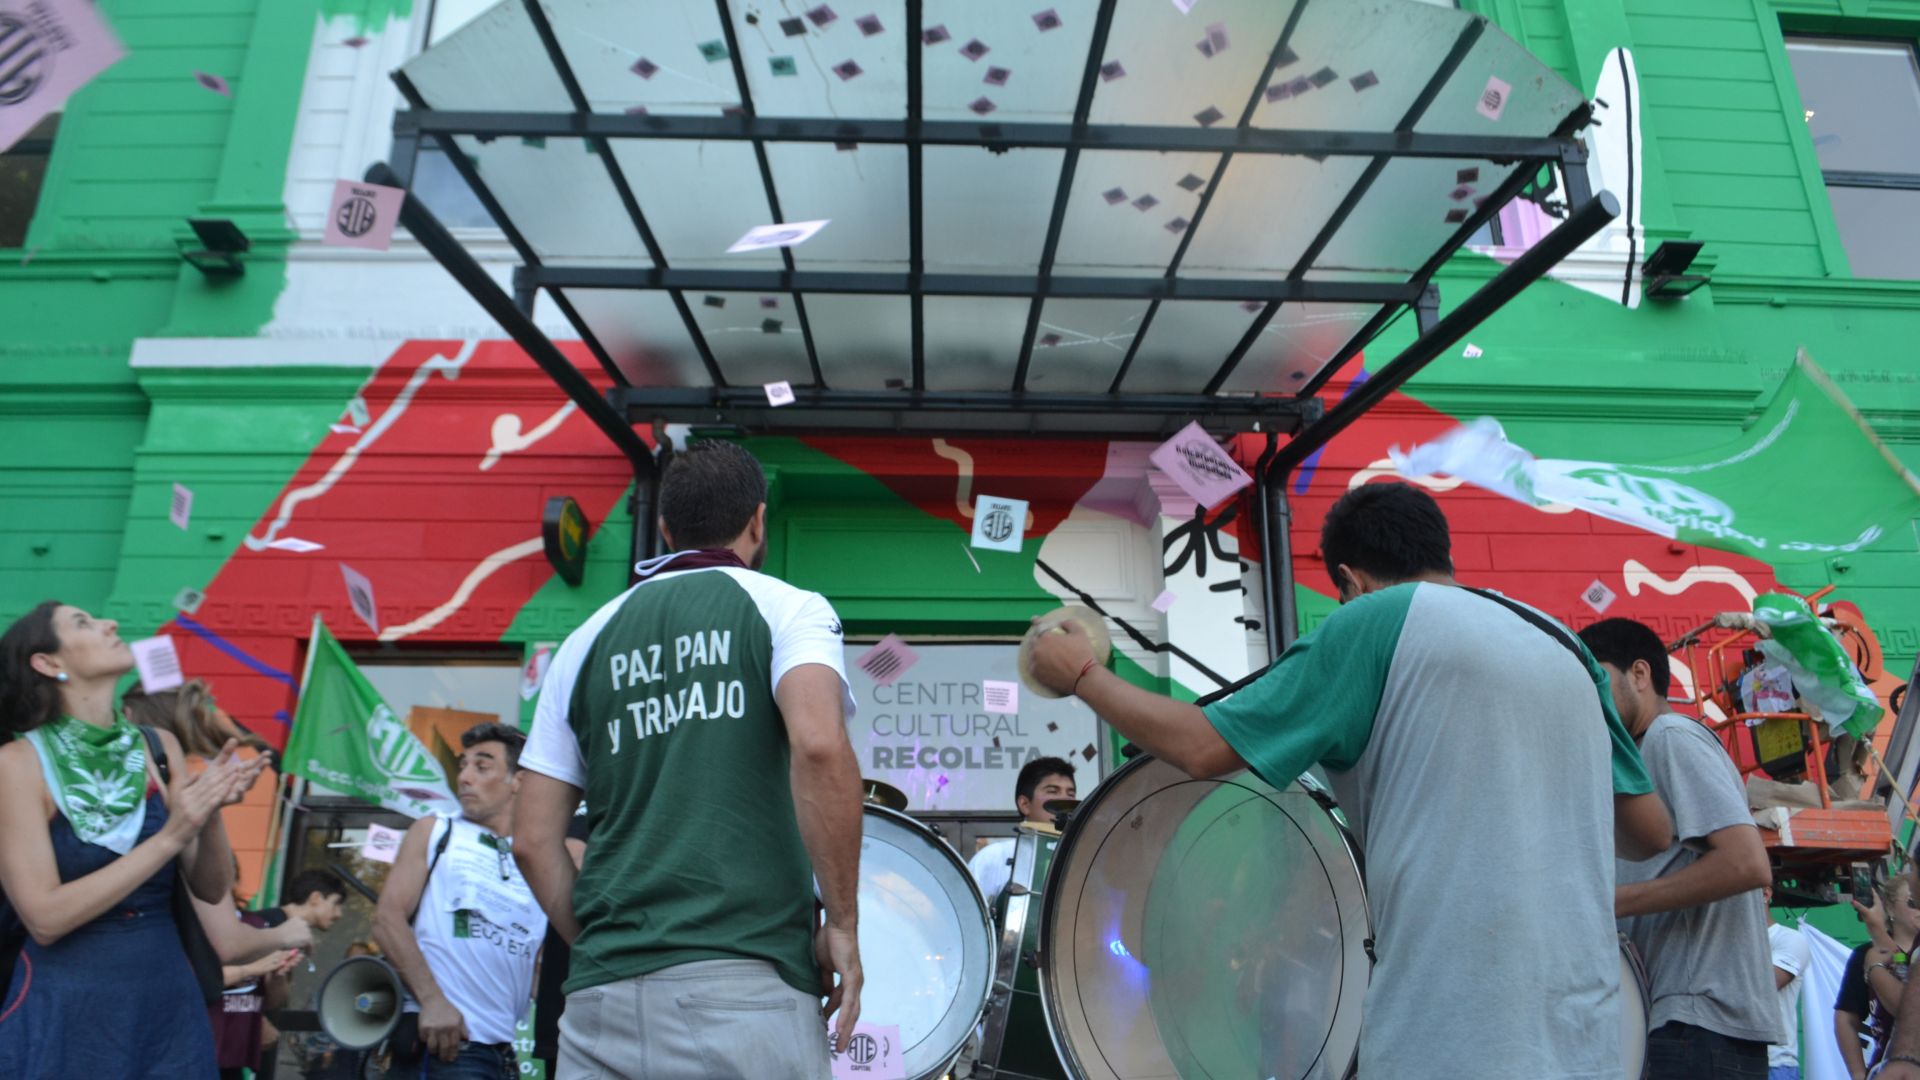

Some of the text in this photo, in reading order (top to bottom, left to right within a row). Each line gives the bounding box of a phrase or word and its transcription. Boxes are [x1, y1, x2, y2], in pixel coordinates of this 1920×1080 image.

[675, 630, 731, 673] PAN
[872, 682, 982, 705] CENTR
[607, 719, 621, 755] y
[872, 714, 1029, 737] CULTURAL
[872, 746, 1043, 769] RECOLETA
[847, 1033, 877, 1064] ATE
